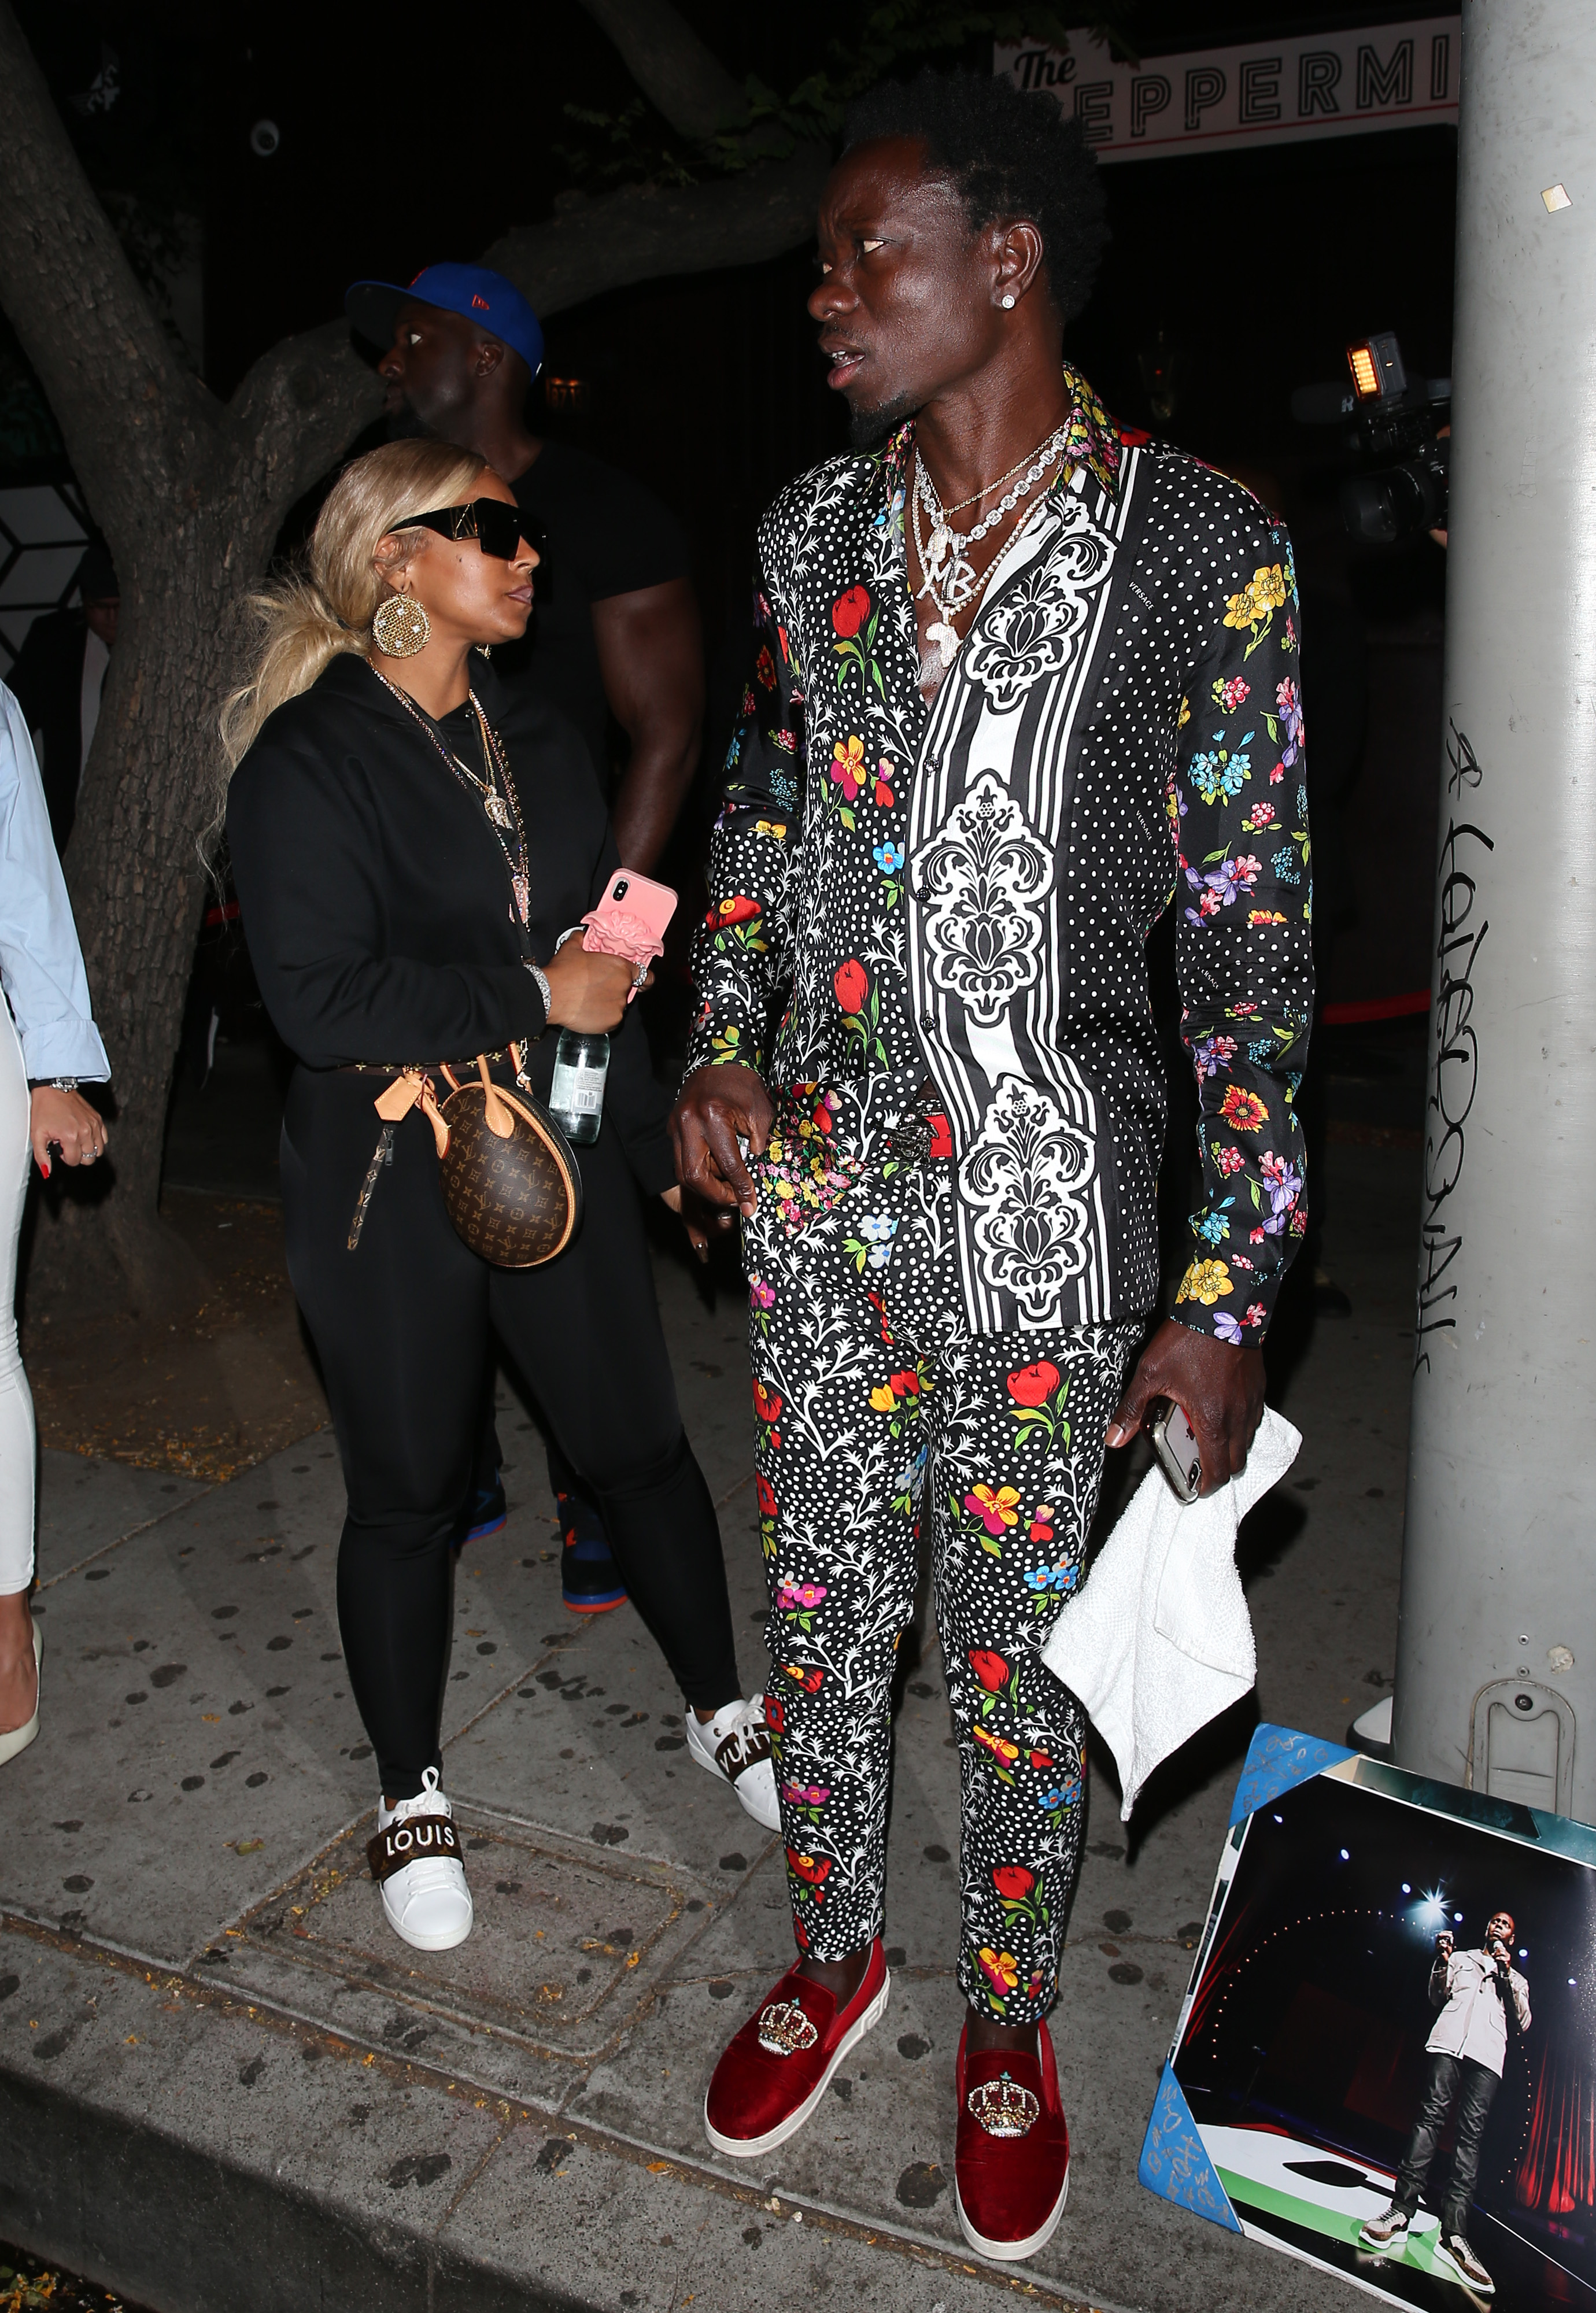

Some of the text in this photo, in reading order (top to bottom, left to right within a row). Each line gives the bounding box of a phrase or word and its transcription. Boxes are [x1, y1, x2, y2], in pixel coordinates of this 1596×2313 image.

[1014, 50, 1077, 88] The
[1074, 34, 1450, 143] EPPERMI
[1129, 581, 1155, 611] VERSACE
[1136, 810, 1153, 842] VERSACE
[719, 1731, 770, 1773] VUITT
[386, 1824, 455, 1857] LOUIS
